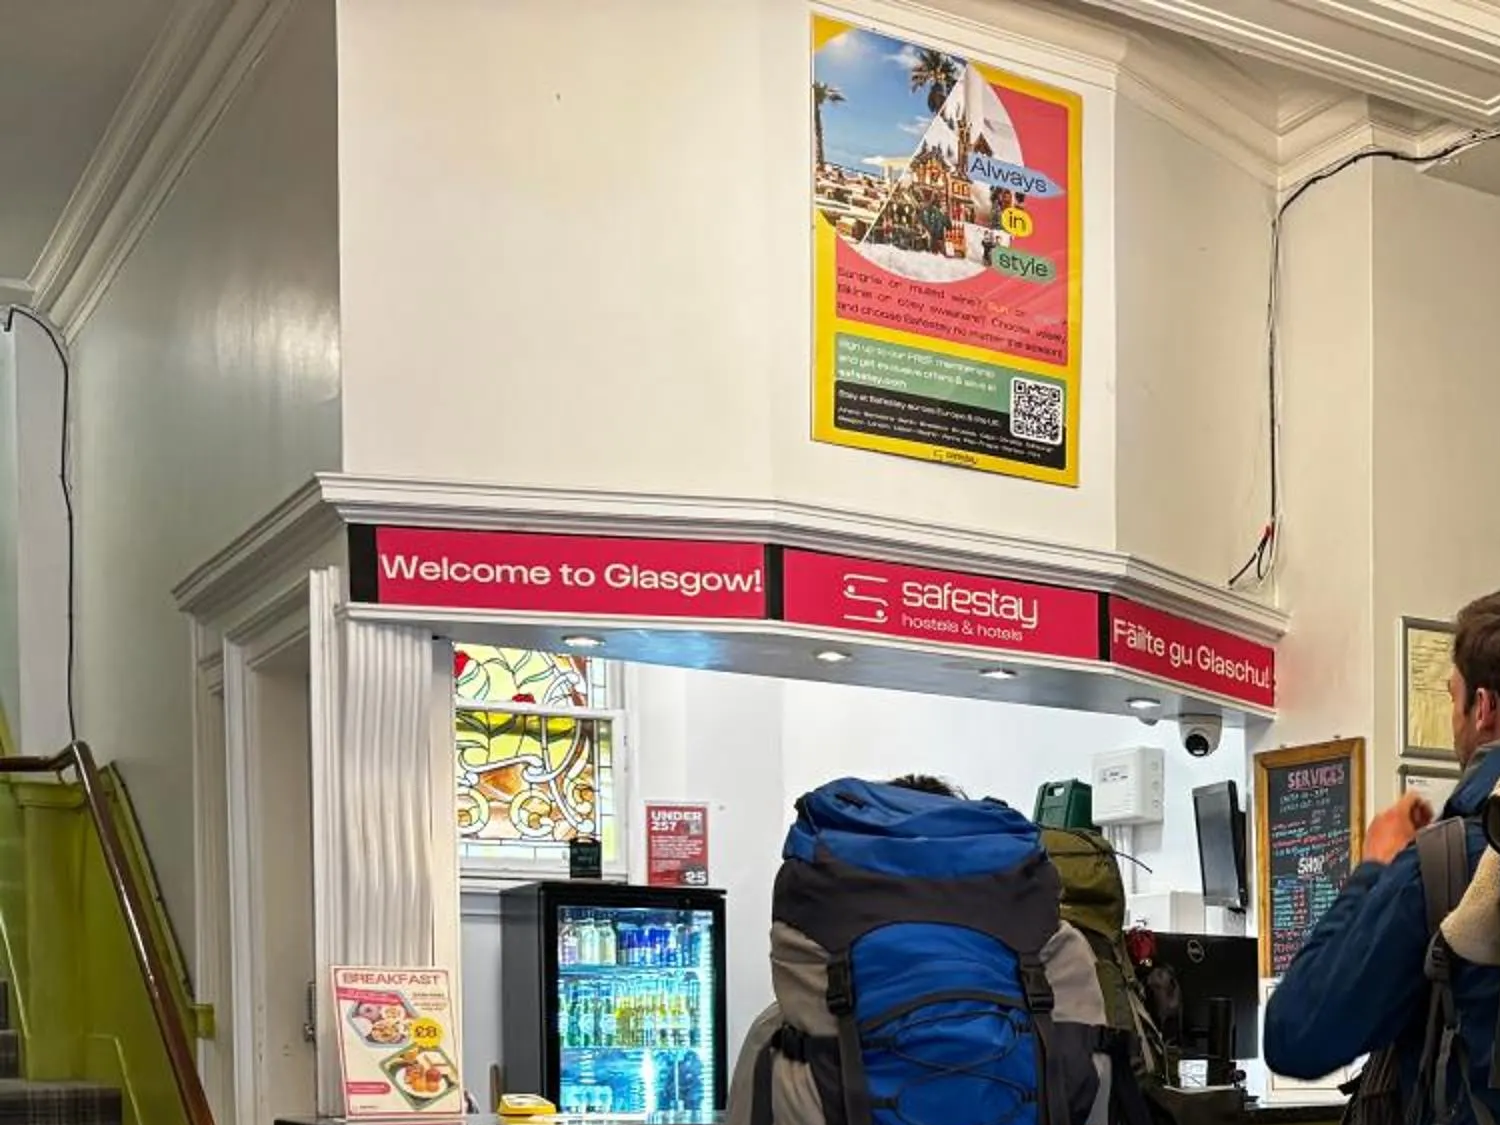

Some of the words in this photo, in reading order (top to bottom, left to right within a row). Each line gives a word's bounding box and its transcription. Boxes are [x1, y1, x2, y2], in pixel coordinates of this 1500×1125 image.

[970, 157, 1047, 192] Always
[1009, 210, 1027, 232] in
[1000, 252, 1048, 276] style
[381, 553, 550, 585] Welcome
[559, 563, 596, 587] to
[604, 563, 764, 597] Glasgow!
[902, 581, 1038, 629] safestay
[902, 613, 959, 633] hostels
[962, 620, 974, 635] &
[977, 624, 1023, 641] hotels
[1169, 642, 1193, 668] gu
[1197, 645, 1270, 689] Glaschu!
[651, 810, 702, 820] UNDER
[343, 973, 440, 985] BREAKFAST
